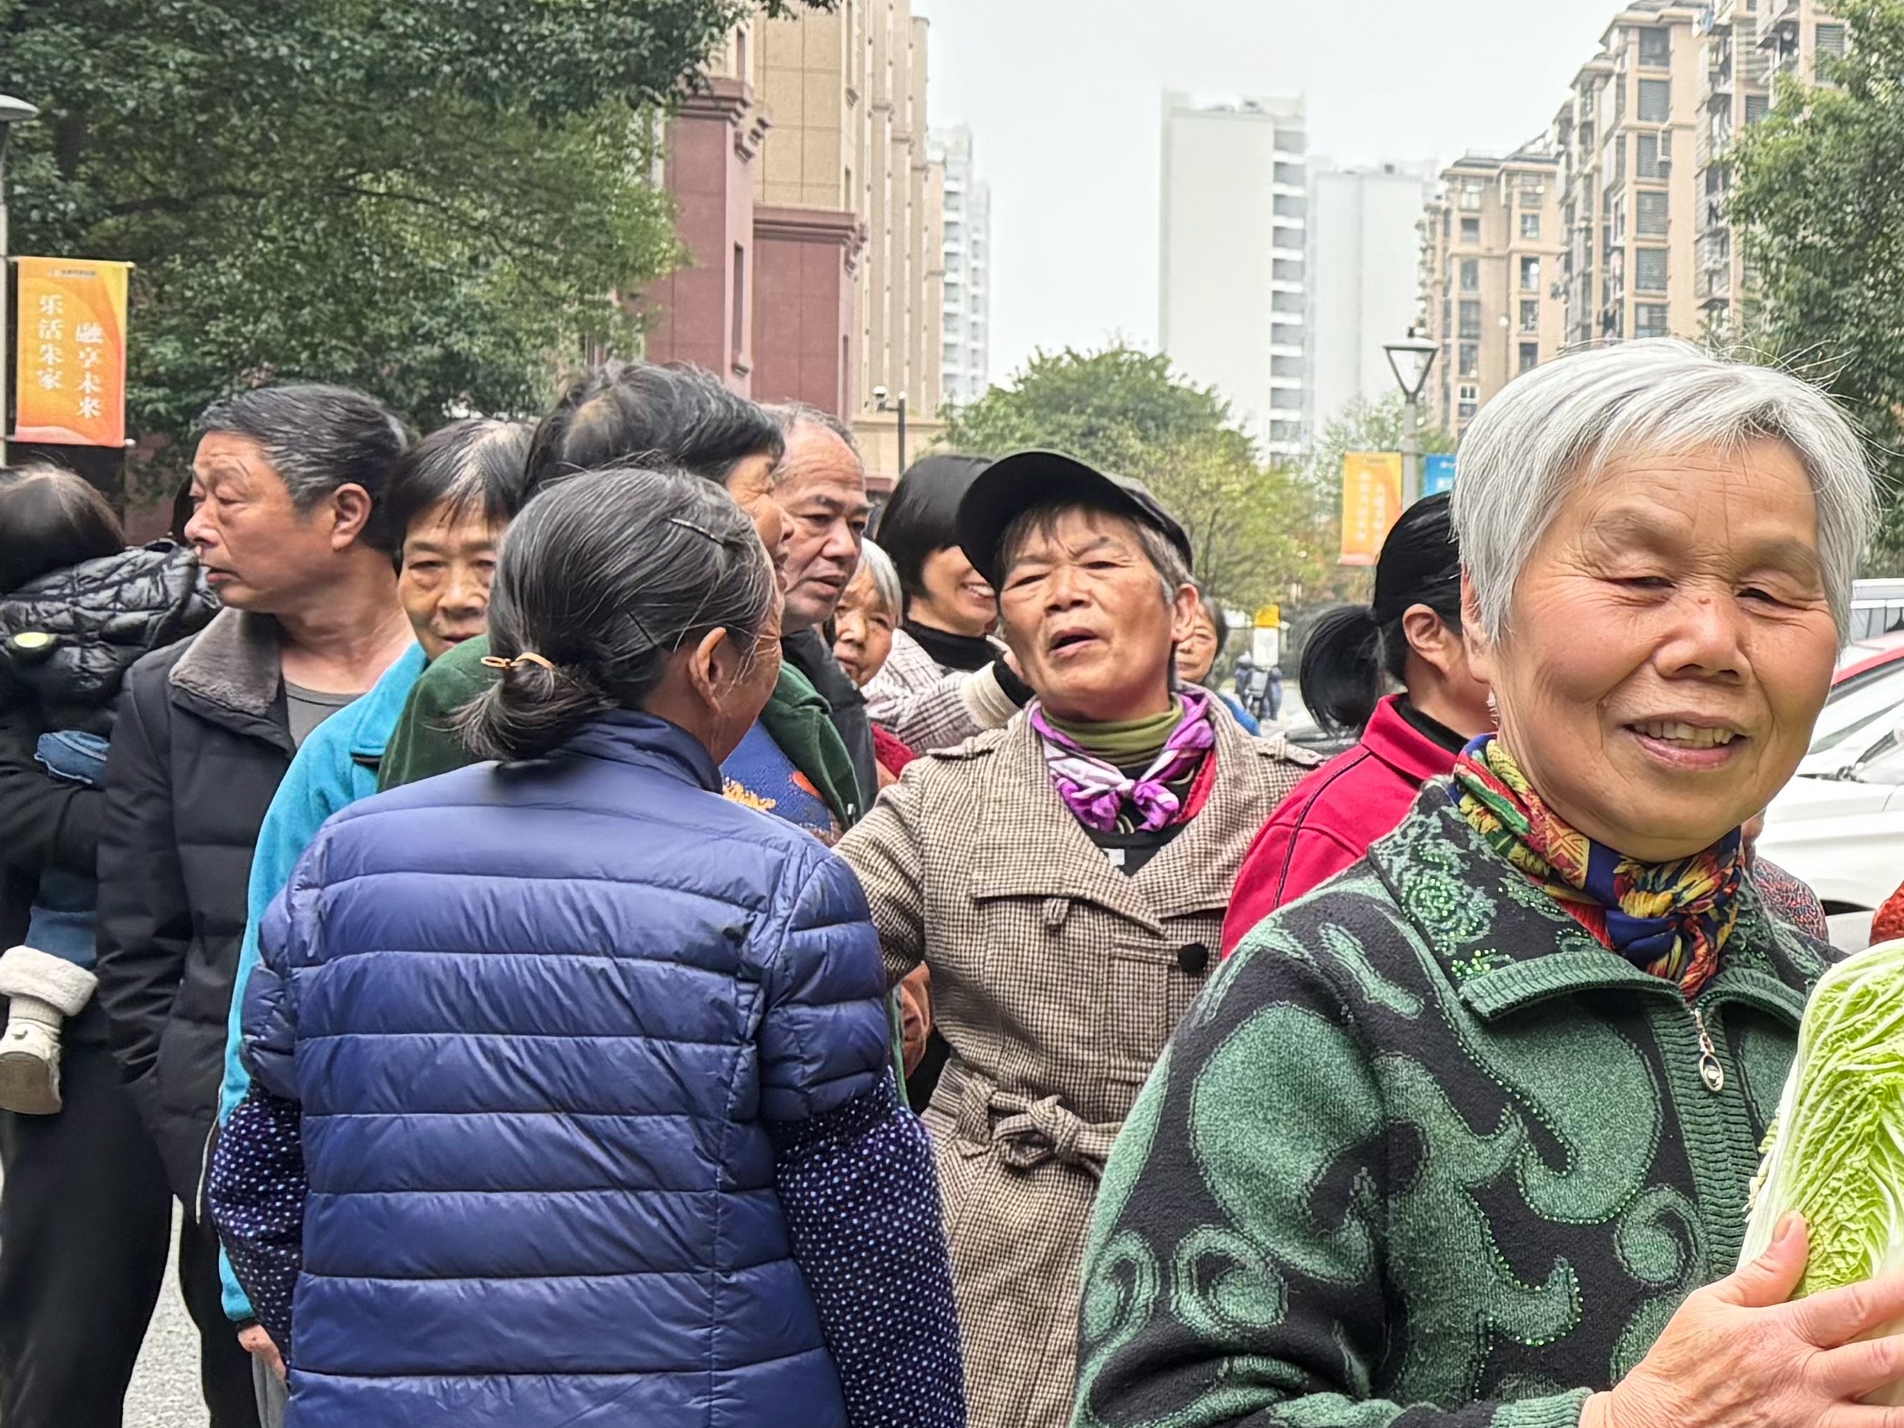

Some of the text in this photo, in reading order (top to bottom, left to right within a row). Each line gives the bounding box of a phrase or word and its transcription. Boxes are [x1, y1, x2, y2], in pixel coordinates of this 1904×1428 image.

[37, 294, 64, 390] 乐活朱家
[75, 322, 105, 419] 融享未来
